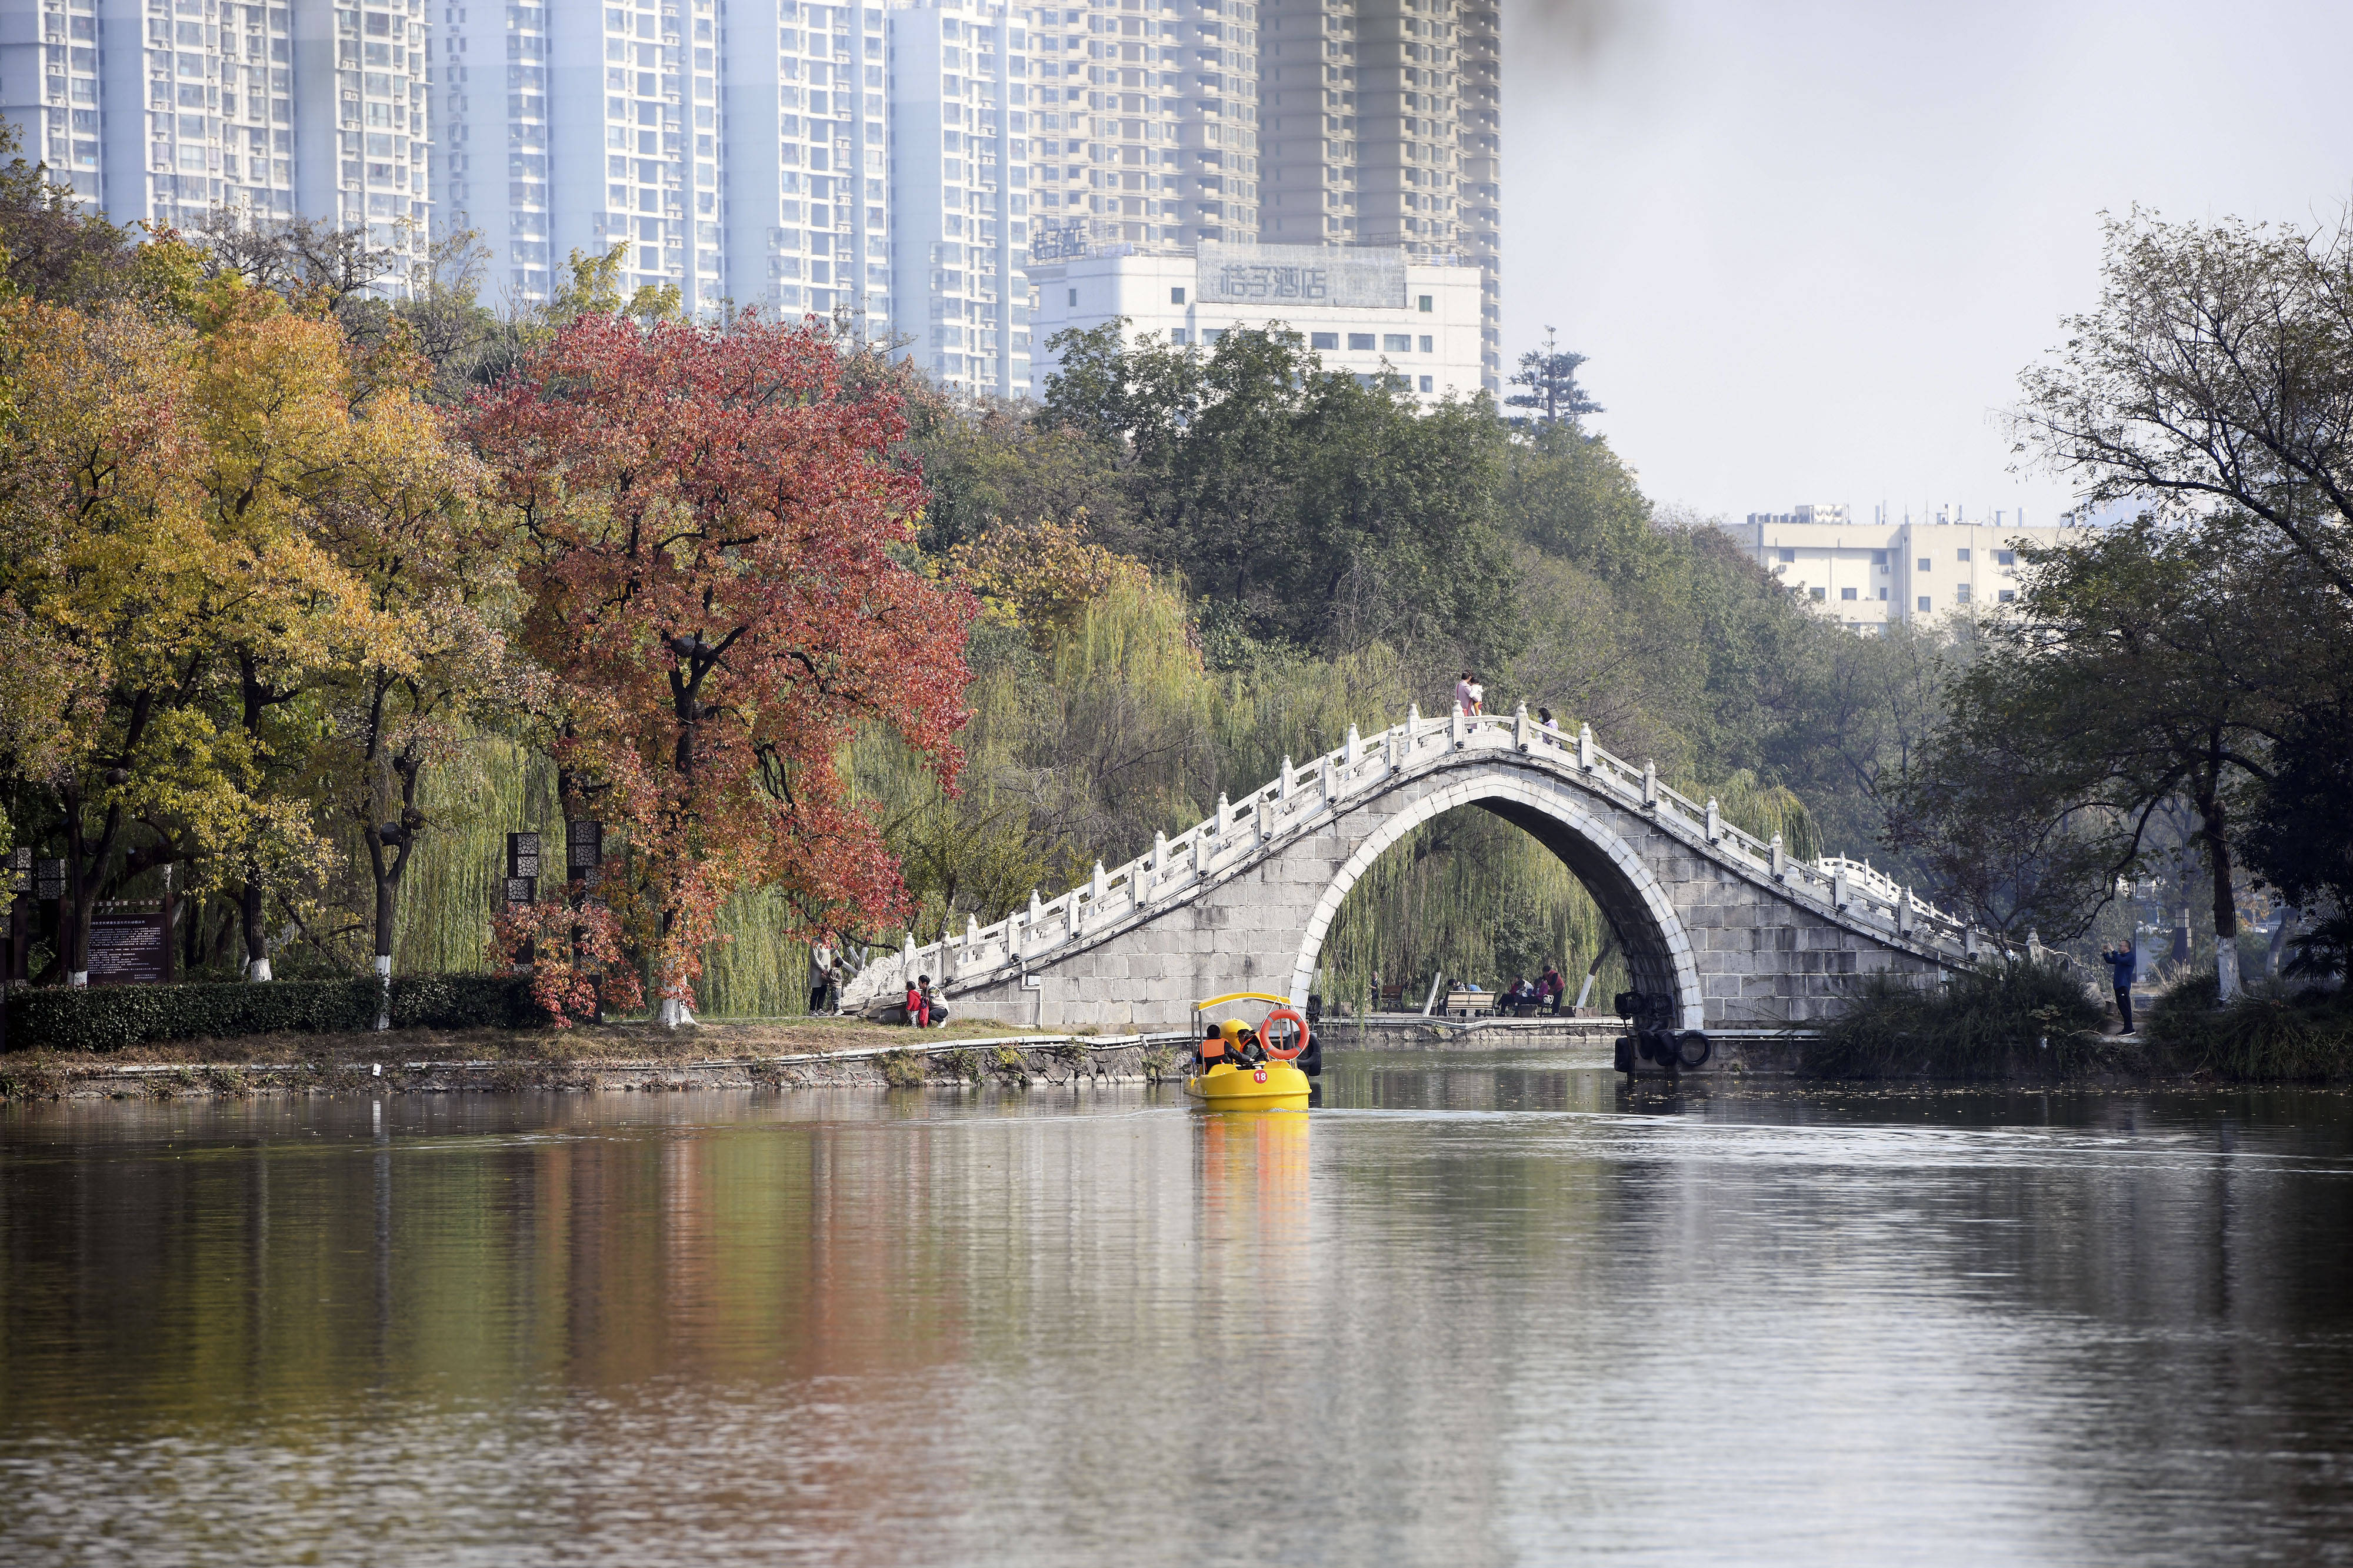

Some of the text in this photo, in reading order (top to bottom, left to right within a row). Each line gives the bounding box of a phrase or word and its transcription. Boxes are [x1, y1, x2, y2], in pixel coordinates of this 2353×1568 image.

[1221, 265, 1327, 298] 桔子酒店
[1255, 1073, 1267, 1081] 18
